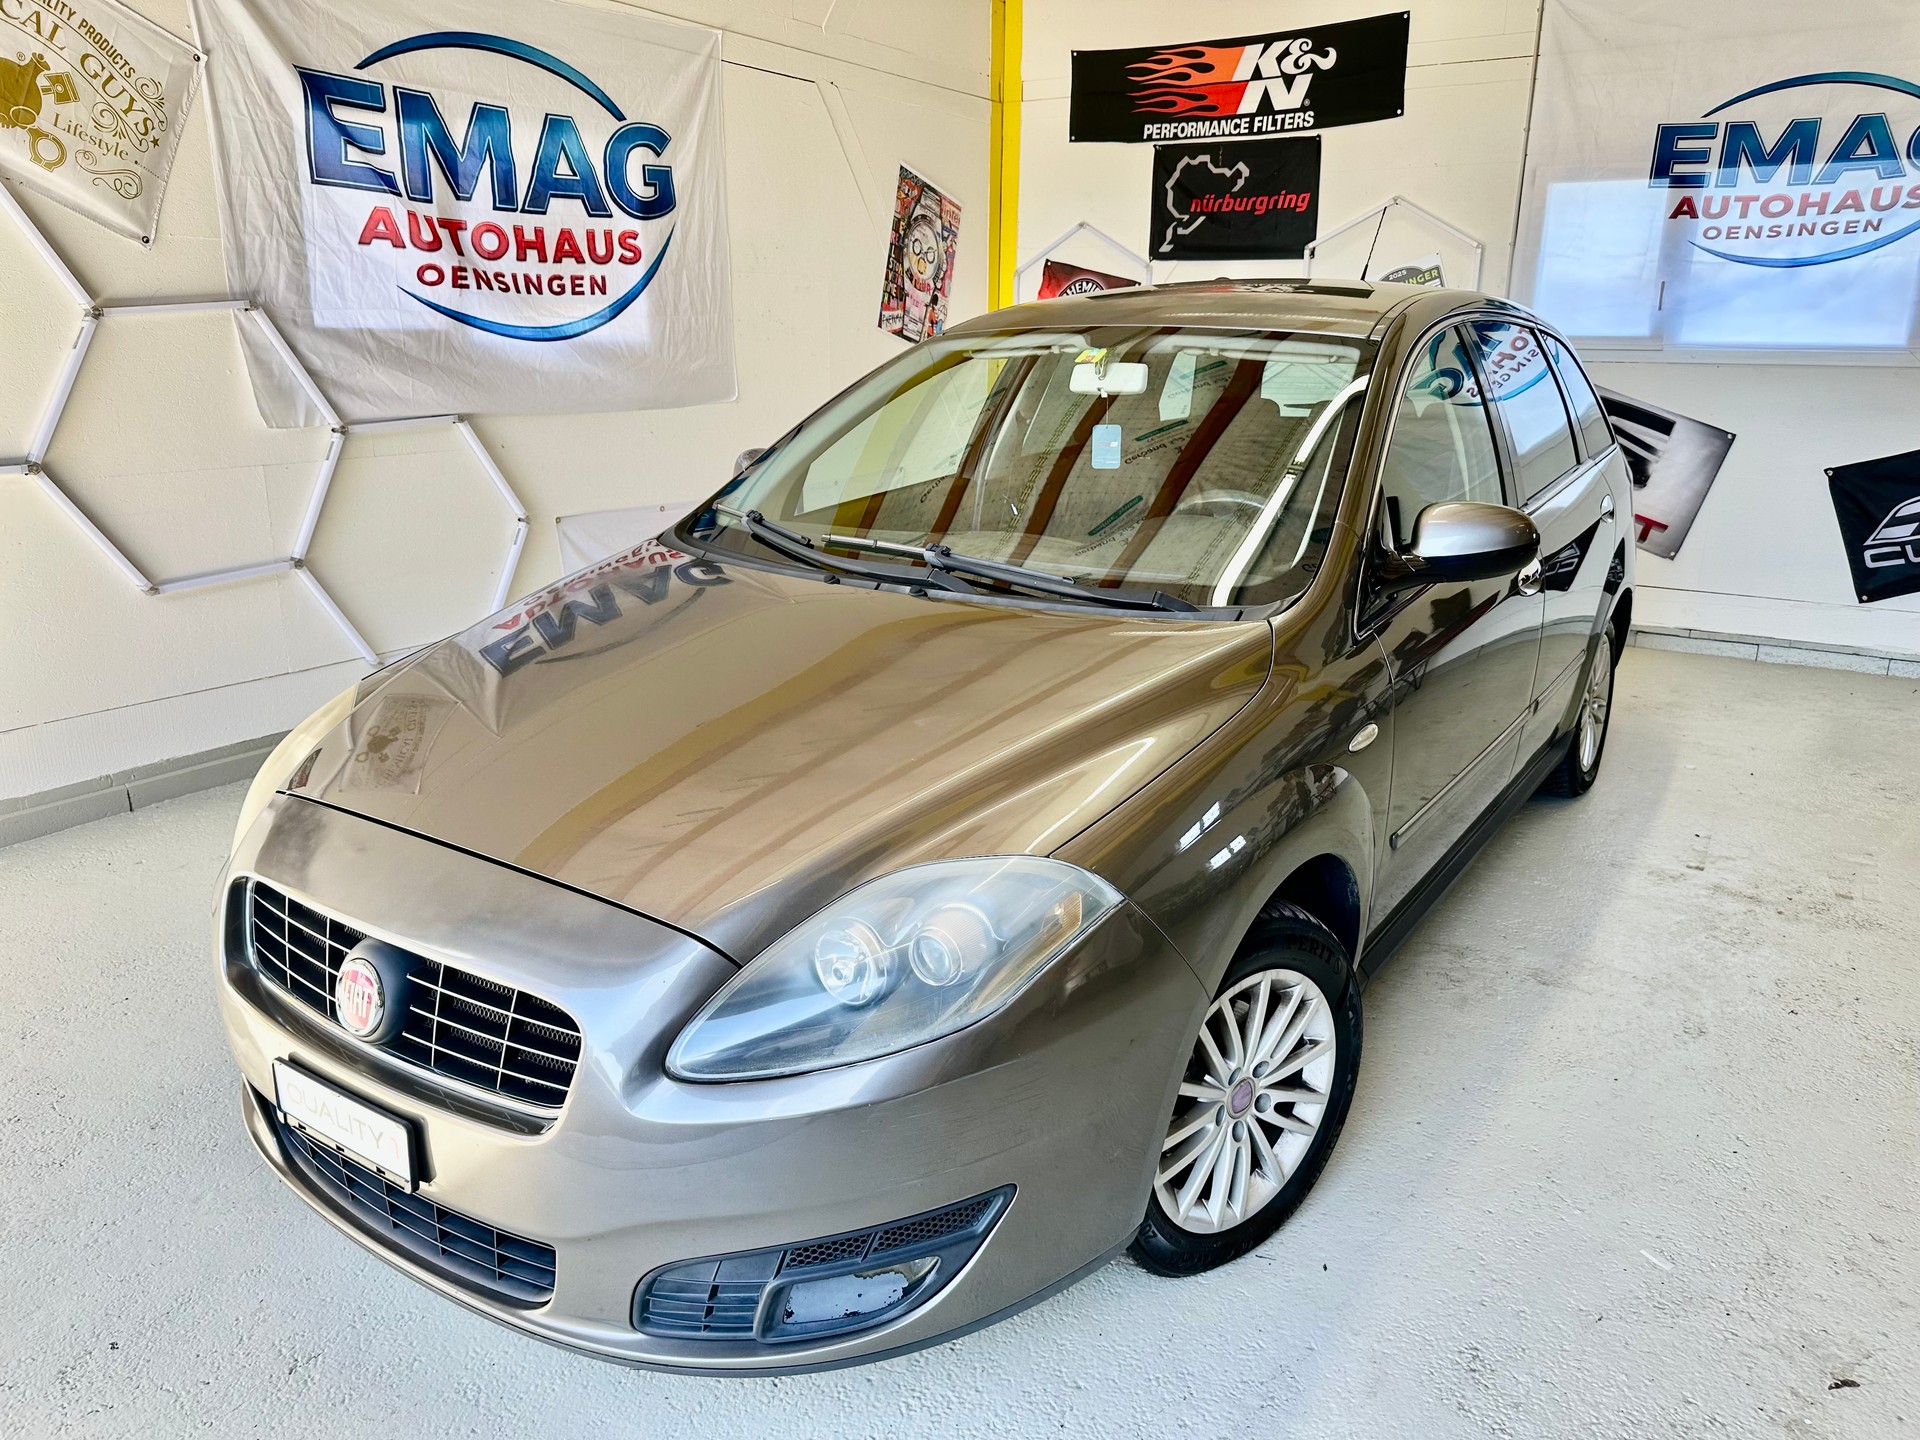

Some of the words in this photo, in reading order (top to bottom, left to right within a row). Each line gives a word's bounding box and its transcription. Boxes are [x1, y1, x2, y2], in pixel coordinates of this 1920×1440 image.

[78, 18, 136, 79] PRODUCTS
[80, 53, 155, 137] GUYS
[52, 113, 130, 162] Lifestyle
[293, 64, 677, 221] EMAG
[1143, 118, 1250, 141] PERFORMANCE
[1253, 111, 1315, 132] FILTERS
[1648, 112, 1920, 189] EMA
[1190, 190, 1311, 216] nürburgring
[358, 206, 643, 266] AUTOHAUS
[1703, 218, 1883, 240] OENSINGEN
[416, 263, 608, 296] OENSINGEN
[1388, 269, 1407, 281] 2025
[1404, 269, 1439, 285] NGER
[286, 1081, 384, 1150] QUALITY
